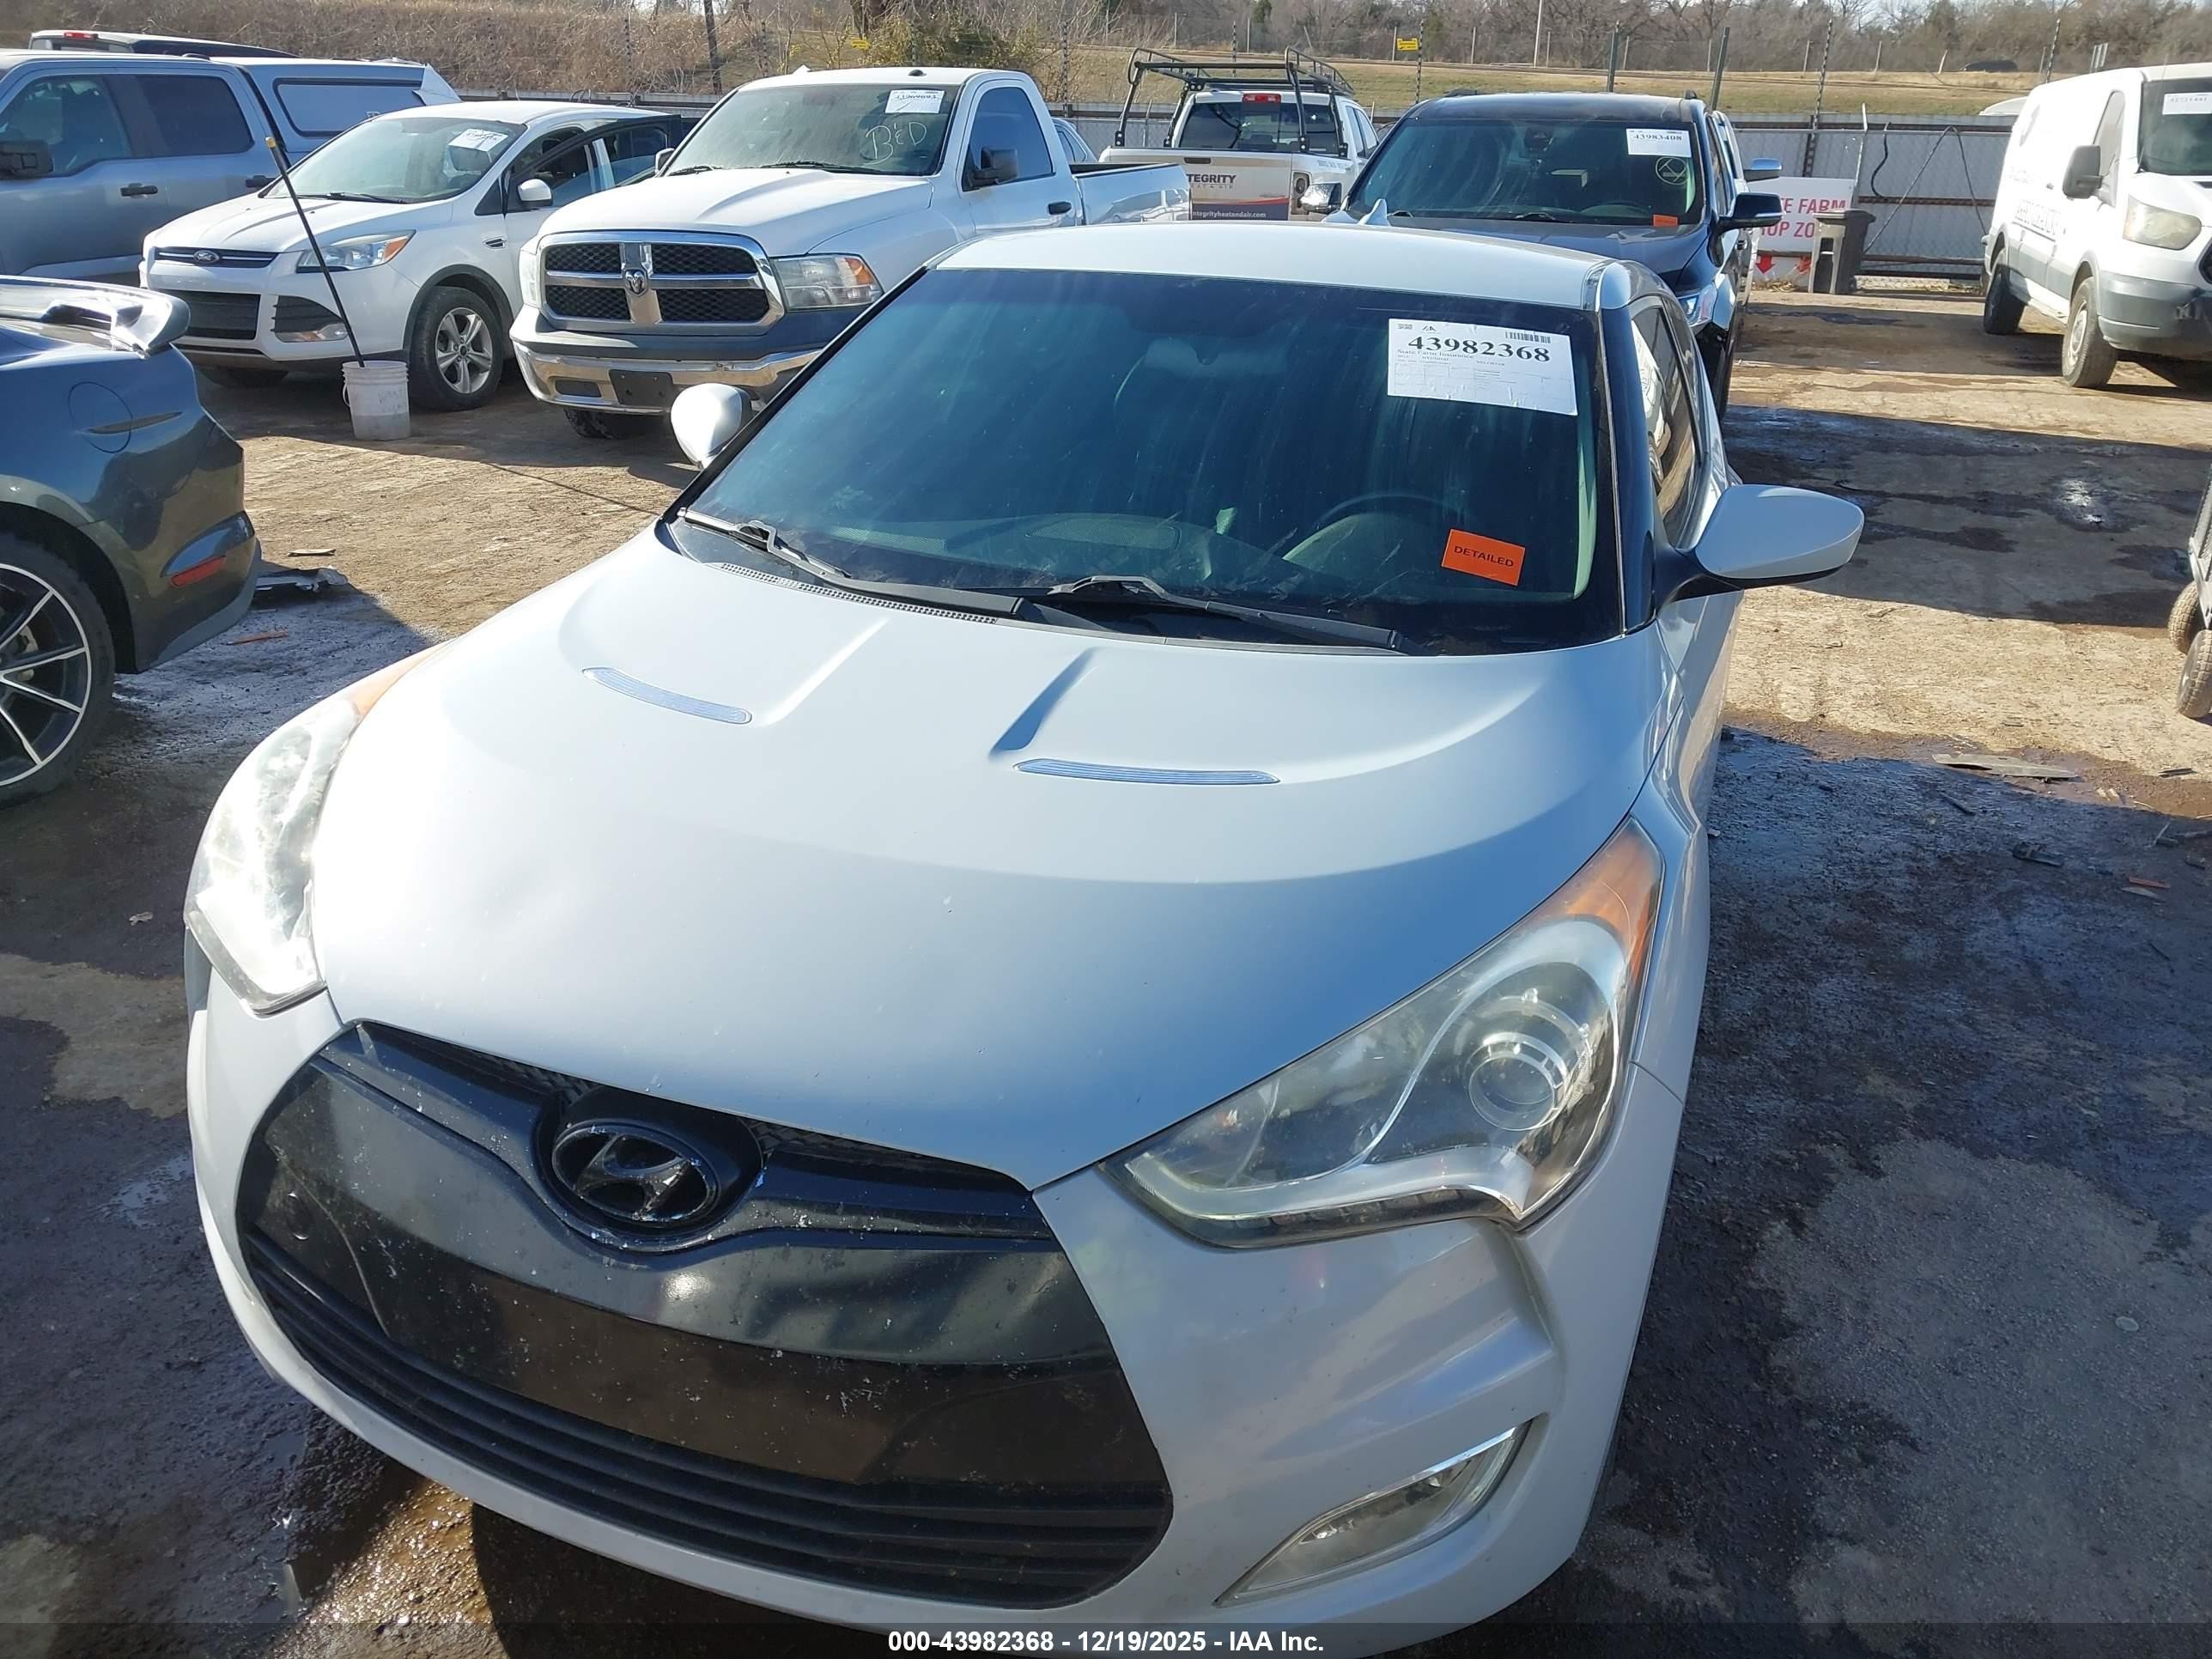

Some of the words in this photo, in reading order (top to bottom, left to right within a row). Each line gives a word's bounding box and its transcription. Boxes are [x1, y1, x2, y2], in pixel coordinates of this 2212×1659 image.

[1187, 173, 1237, 183] TEGRITY
[1408, 336, 1551, 362] 43982368
[1454, 546, 1514, 567] DETAILED
